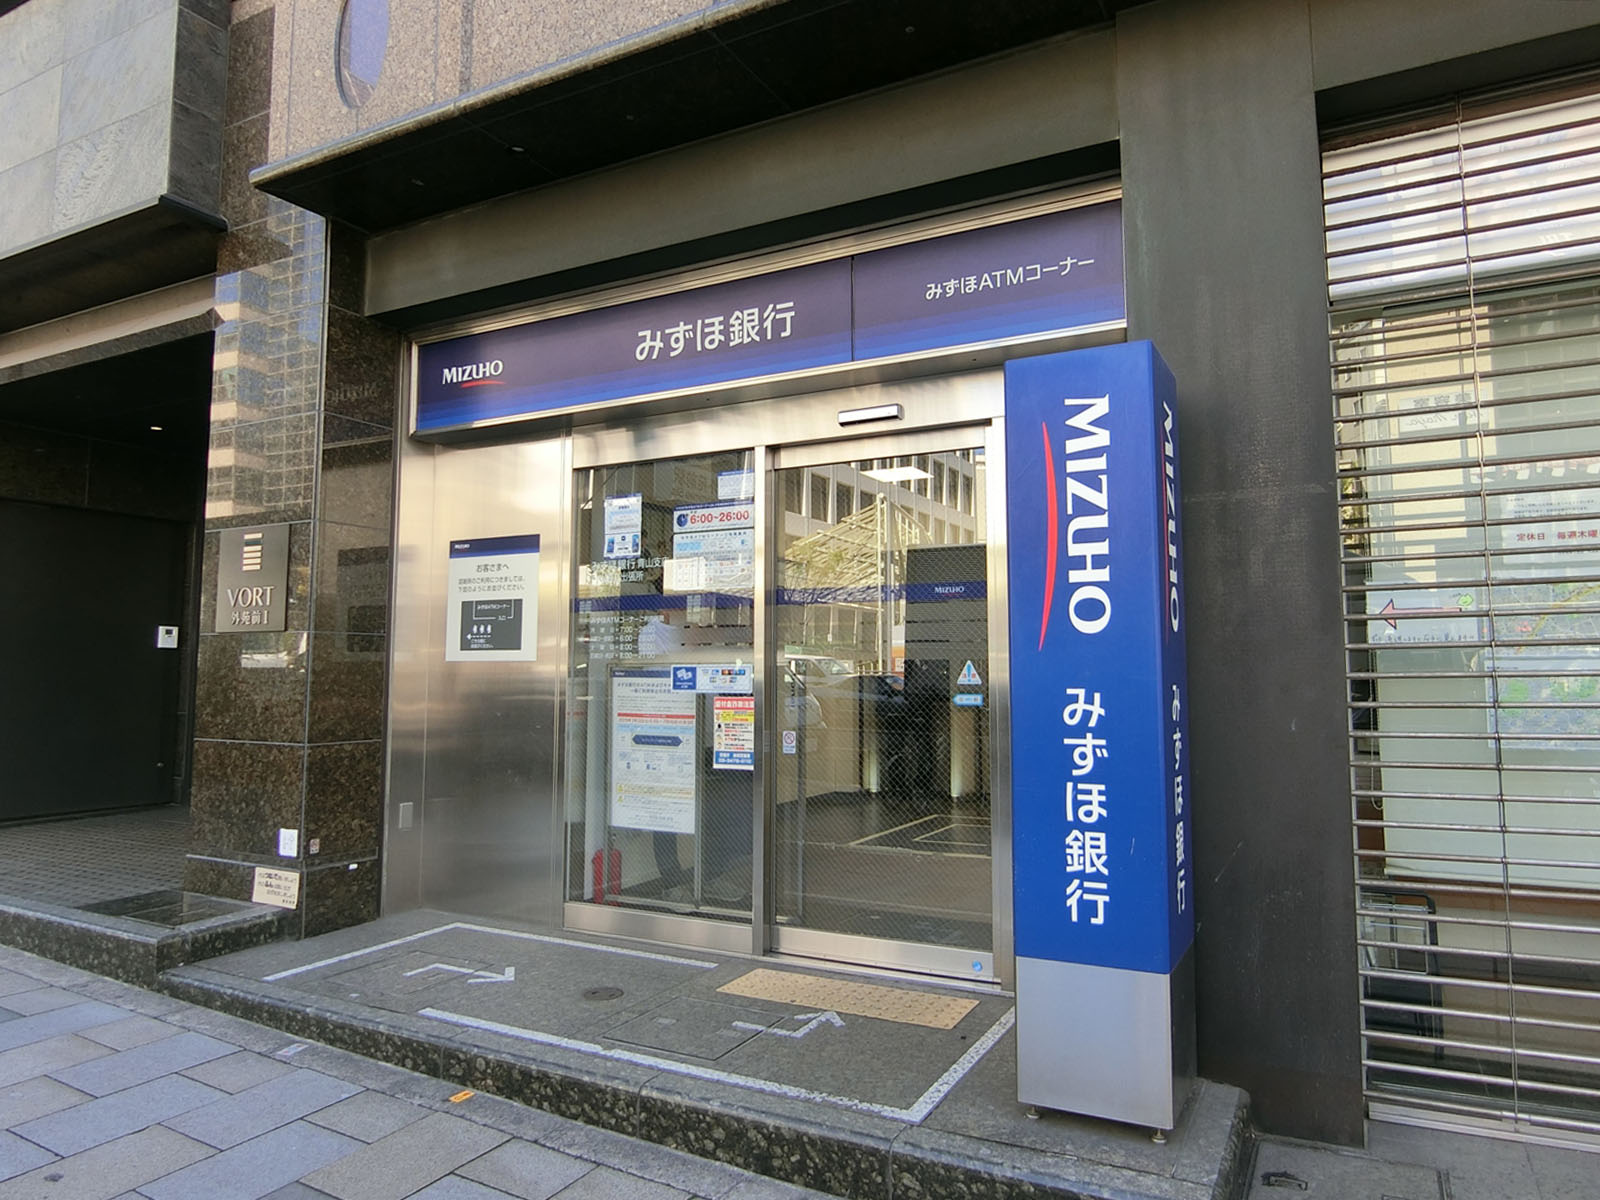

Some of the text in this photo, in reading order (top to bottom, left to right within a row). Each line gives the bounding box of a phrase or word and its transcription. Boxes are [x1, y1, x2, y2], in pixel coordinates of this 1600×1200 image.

[925, 256, 1095, 300] みずほATMコーナー
[635, 301, 796, 361] みずほ銀行
[442, 359, 504, 385] MIZUHO
[690, 510, 750, 525] 6:00~26:00
[1064, 394, 1112, 635] MIZUHO
[1163, 400, 1180, 633] MIZUHO
[1516, 529, 1600, 542] 定休日 毎週木曜
[227, 586, 275, 608] VORT
[934, 585, 965, 594] MIZUHO
[231, 610, 262, 625] 外苑前
[1063, 687, 1111, 925] みずほ銀行
